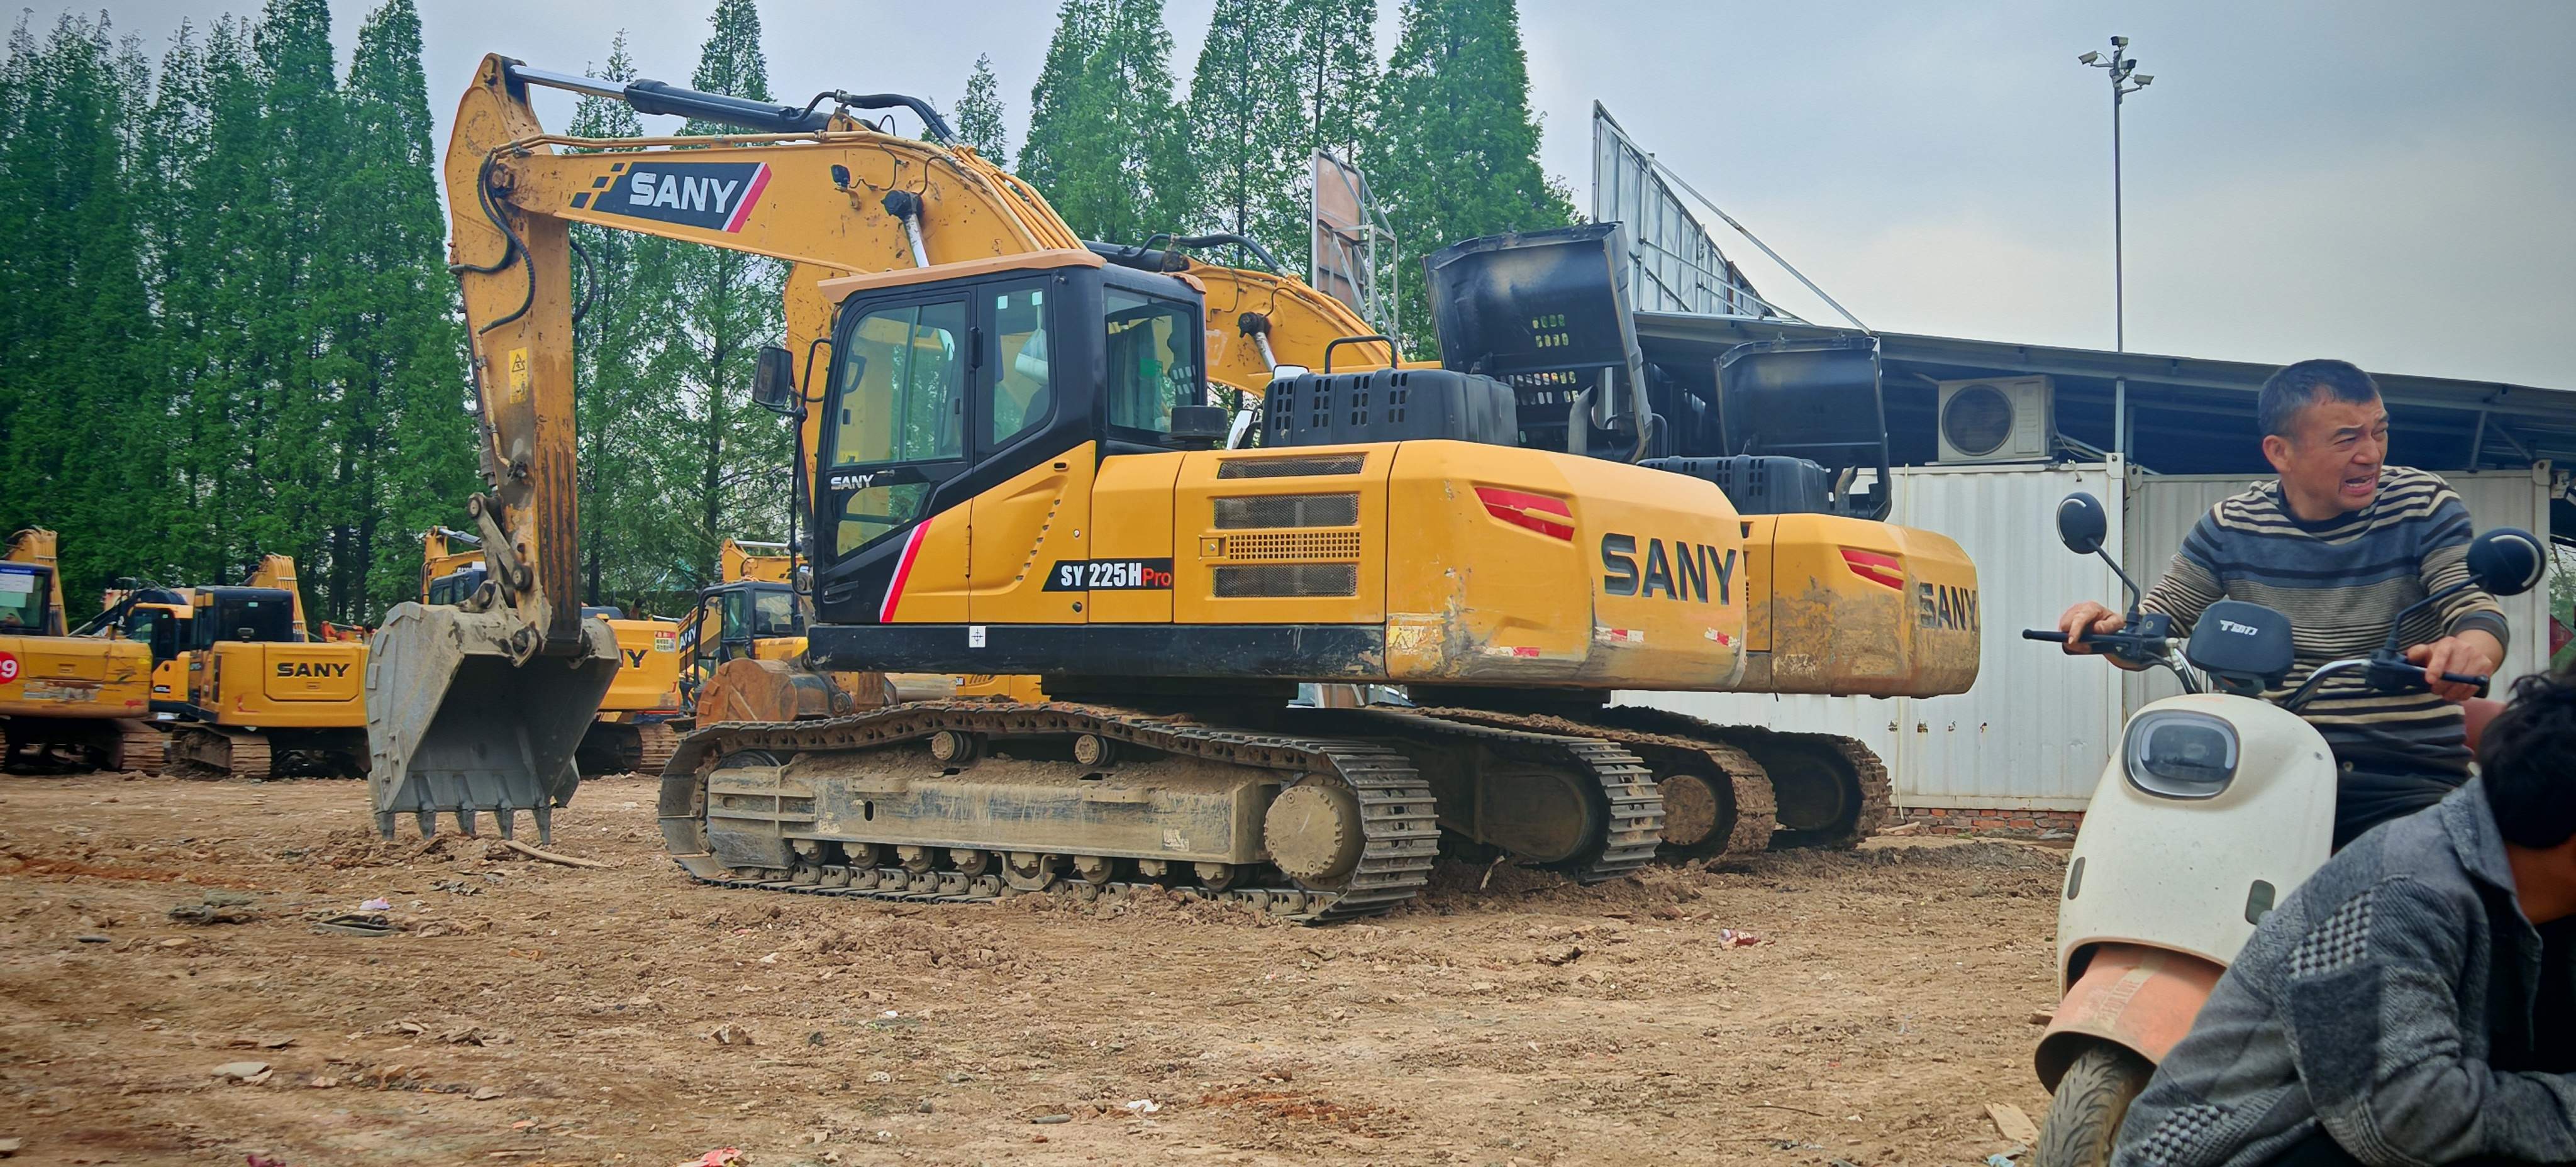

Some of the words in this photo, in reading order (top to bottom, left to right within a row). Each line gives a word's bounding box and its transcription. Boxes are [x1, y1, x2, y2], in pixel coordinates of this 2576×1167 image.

[629, 172, 738, 213] SANY
[830, 473, 874, 490] SANY
[1060, 565, 1084, 586] SY
[1601, 533, 1736, 606] SANY
[1918, 582, 1976, 633] SANY
[277, 662, 351, 678] SANY
